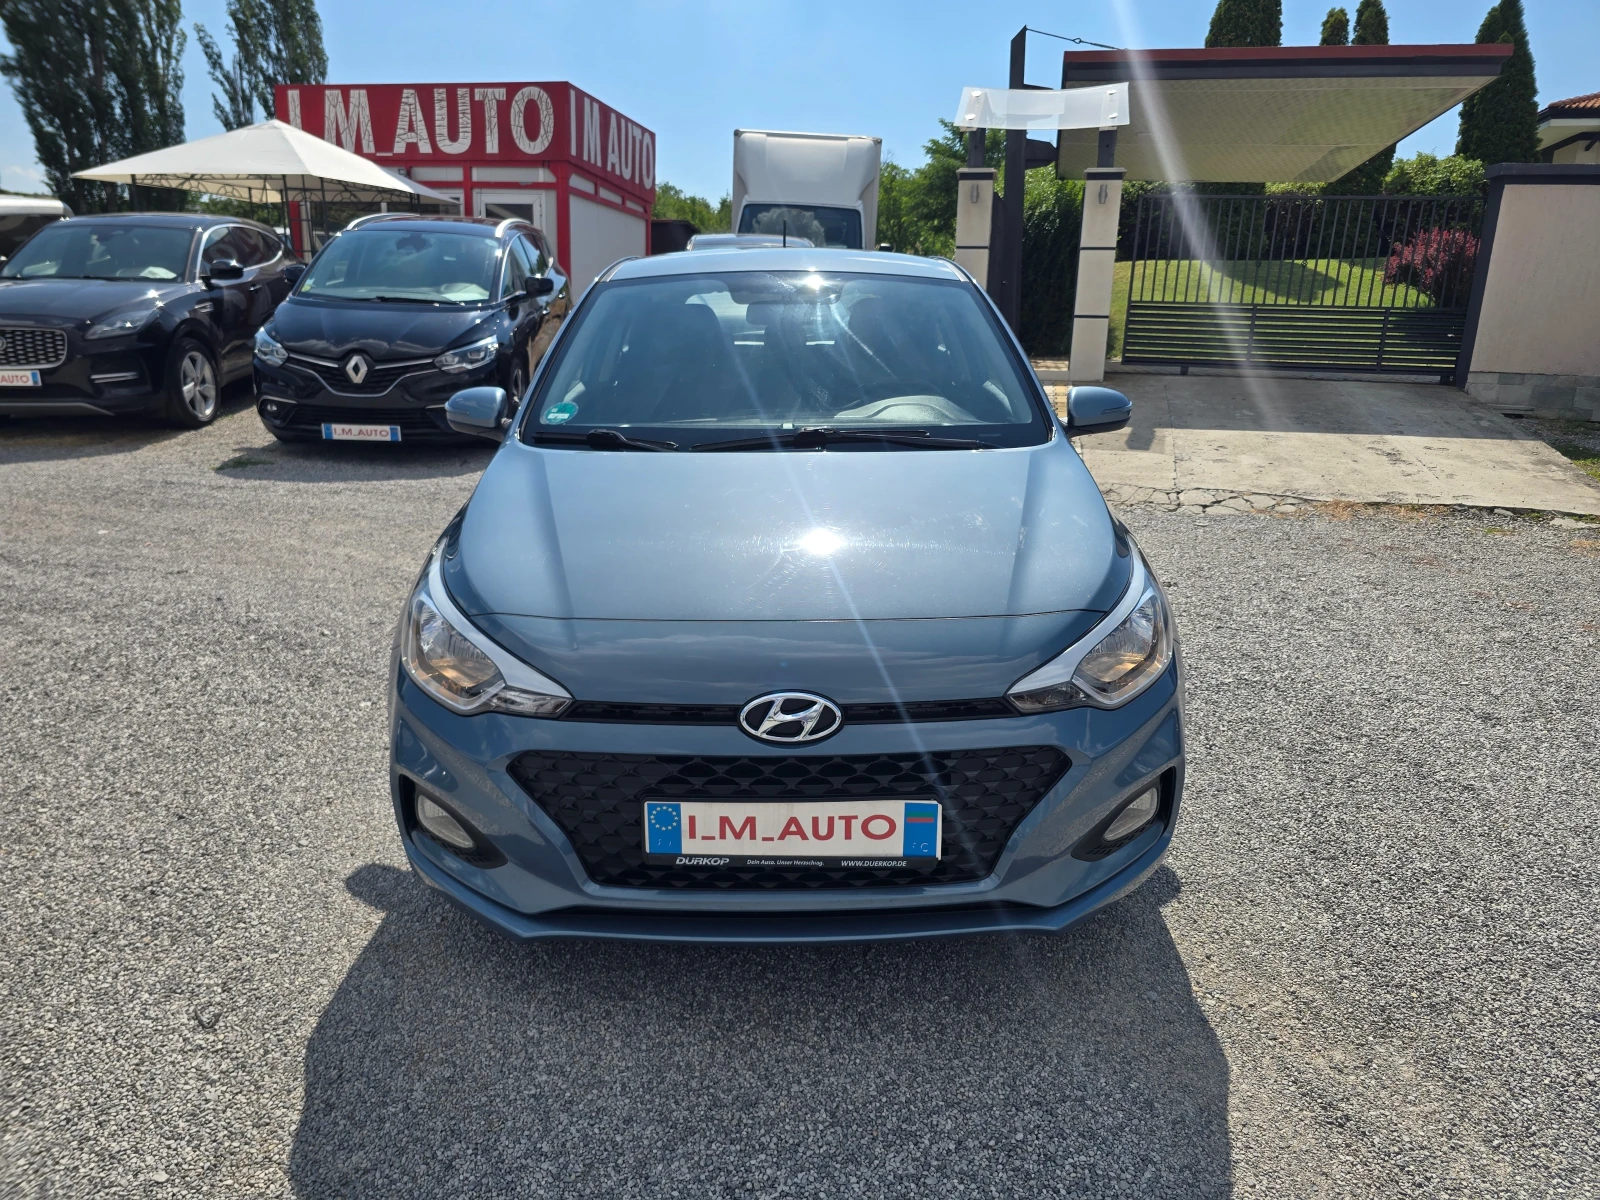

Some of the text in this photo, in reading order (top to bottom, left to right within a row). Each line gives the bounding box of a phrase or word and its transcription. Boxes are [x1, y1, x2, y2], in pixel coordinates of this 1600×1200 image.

[607, 112, 653, 190] AUTO
[333, 427, 389, 438] I_M_AUTO
[688, 814, 897, 842] I_M_AUTO
